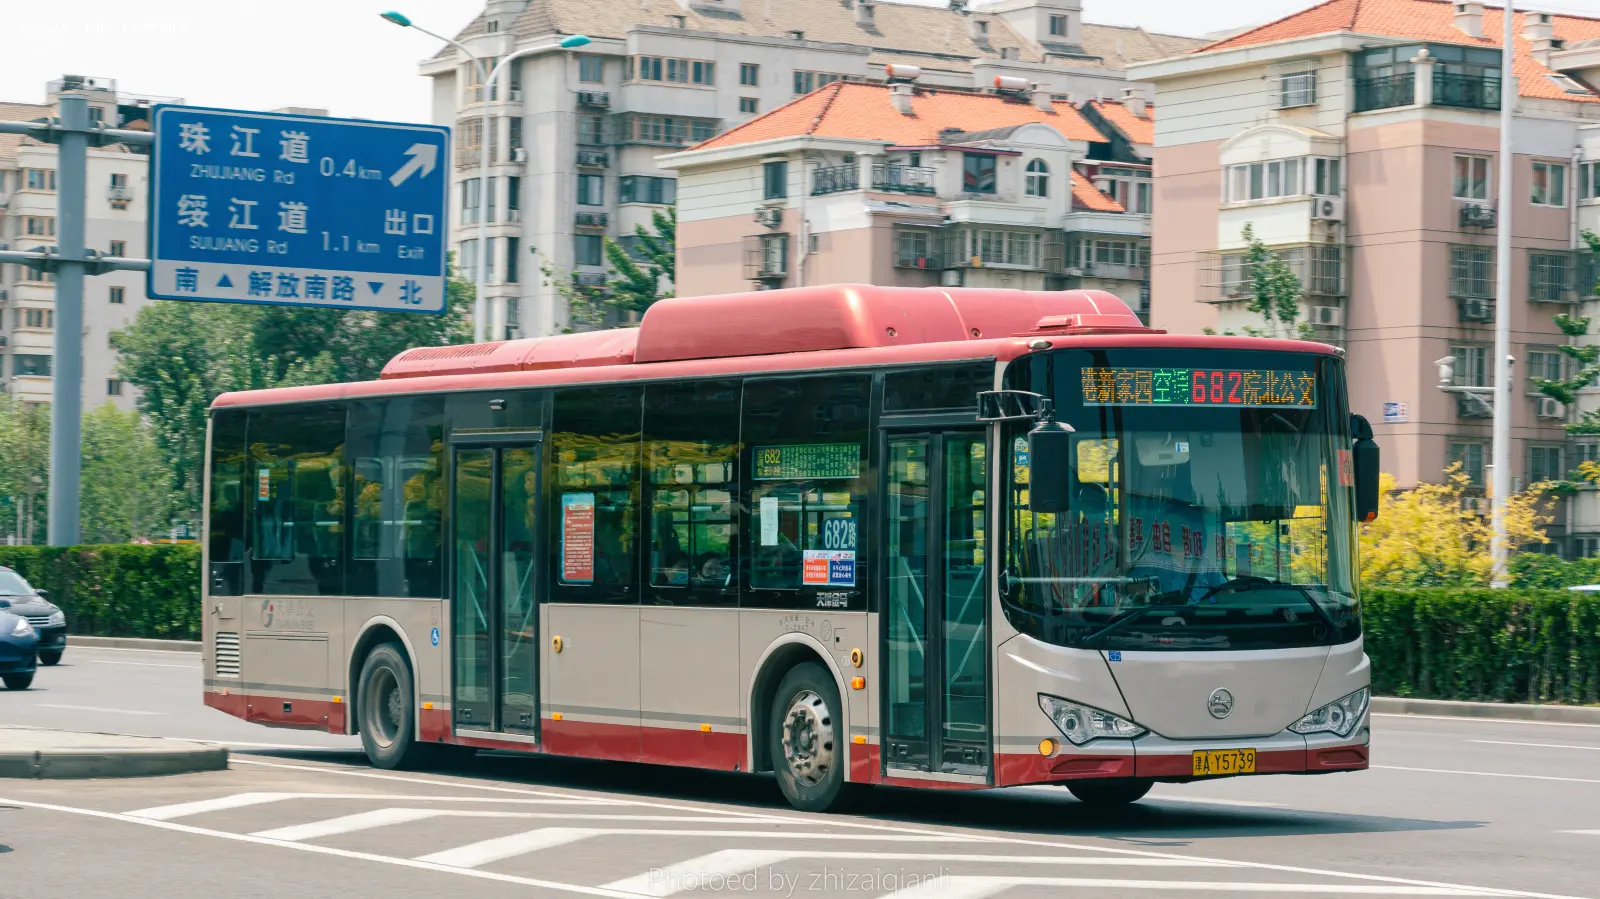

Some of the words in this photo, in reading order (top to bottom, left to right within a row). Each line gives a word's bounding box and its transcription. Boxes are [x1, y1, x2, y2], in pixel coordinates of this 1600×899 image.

[178, 122, 311, 164] 珠江道
[189, 163, 266, 183] ZHUJIANG
[274, 169, 295, 185] Rd
[177, 194, 309, 235] 绥江道
[384, 207, 434, 236] 出口
[189, 235, 260, 253] SUIJIANG
[267, 239, 289, 255] Rd
[321, 231, 349, 252] 1.1
[356, 239, 381, 254] km
[397, 245, 425, 260] Exit
[175, 265, 200, 293] 南
[247, 270, 356, 301] 解放南路
[398, 279, 423, 305] 北
[1192, 371, 1242, 403] 682
[1243, 369, 1315, 405] 院北公交
[764, 448, 781, 464] 682
